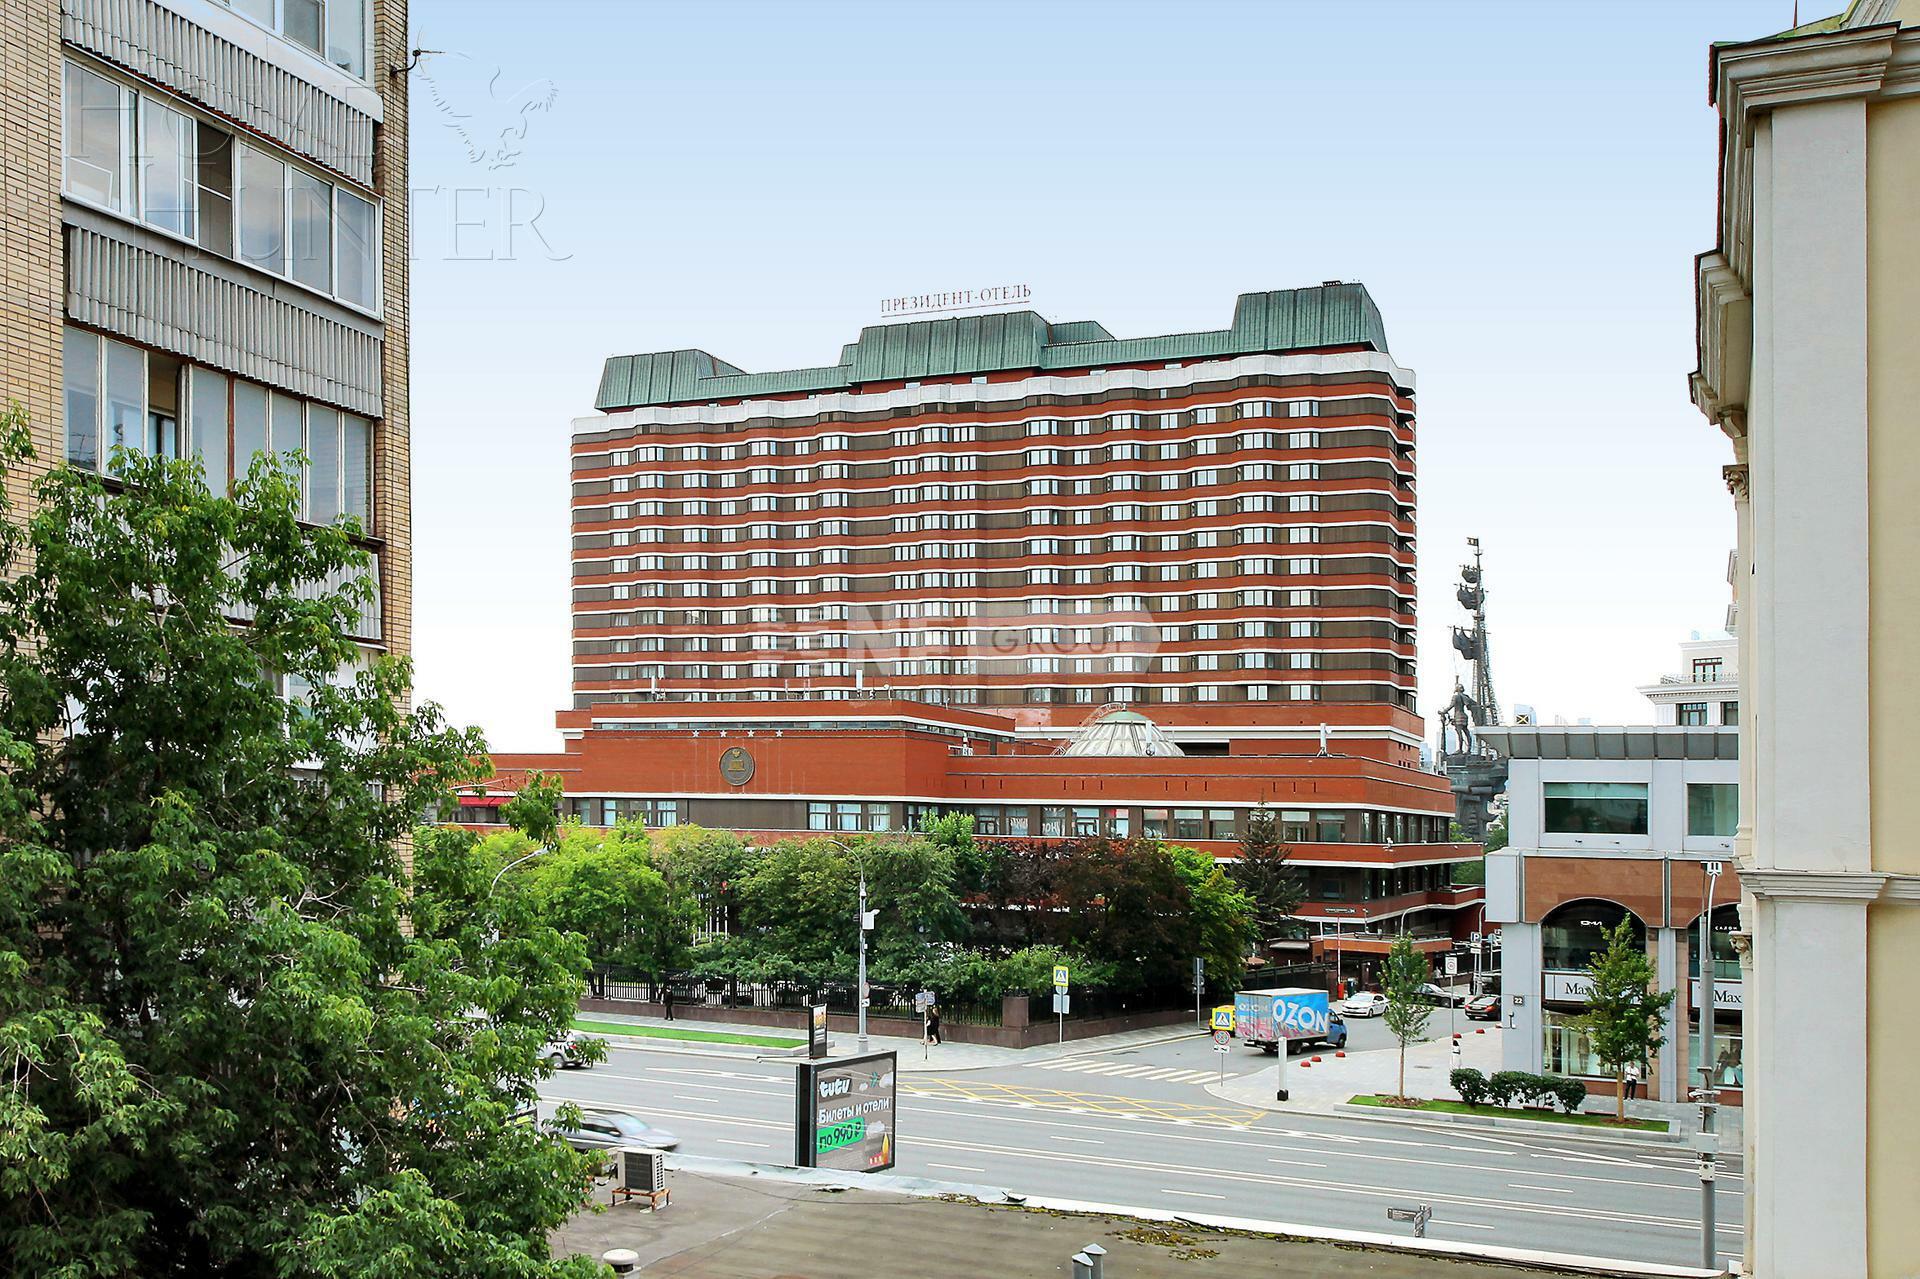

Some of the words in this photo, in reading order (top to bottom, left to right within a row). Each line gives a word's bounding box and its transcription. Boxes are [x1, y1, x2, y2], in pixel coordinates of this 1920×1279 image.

[880, 284, 1031, 313] ПРЕЗИДЕНТ-ОТЕЛЬ
[1713, 989, 1742, 1004] Max
[1273, 998, 1328, 1033] OZON
[819, 1078, 851, 1098] tutu
[818, 1107, 854, 1124] Билеты
[855, 1105, 862, 1116] и
[863, 1097, 889, 1113] отели
[819, 1134, 832, 1149] по
[833, 1124, 853, 1143] 990
